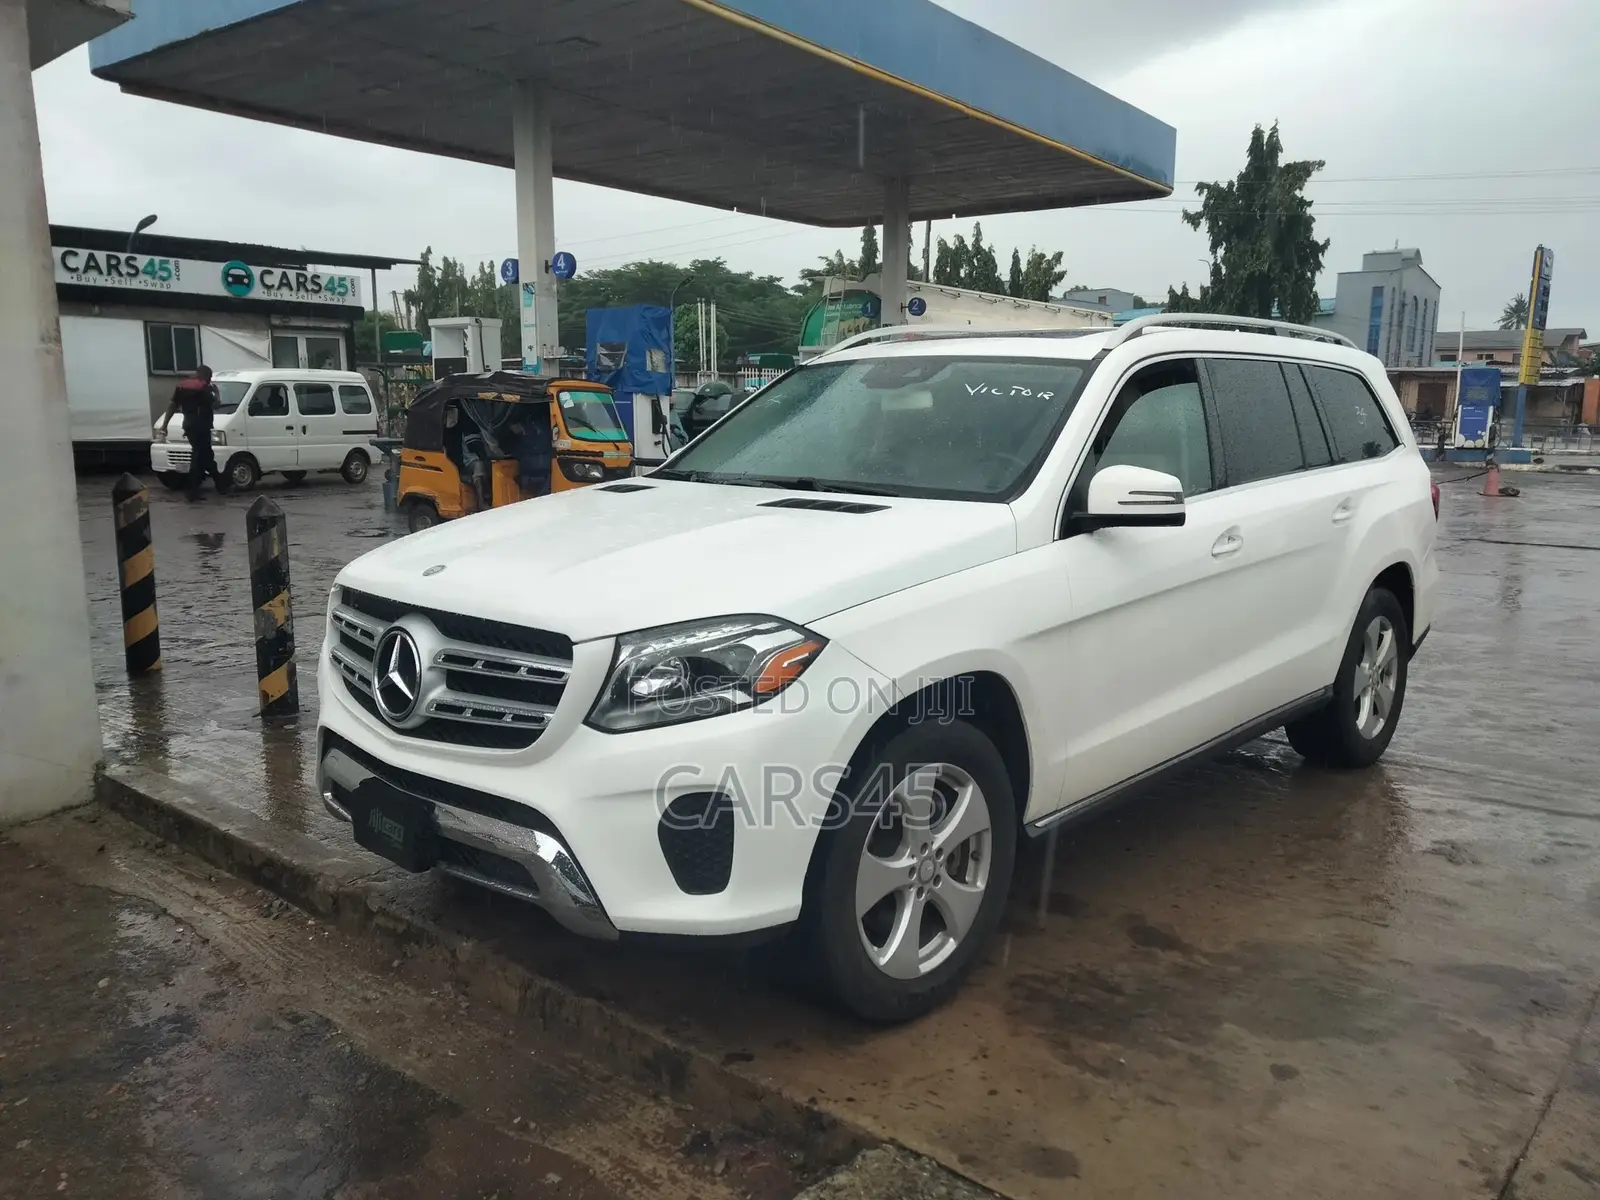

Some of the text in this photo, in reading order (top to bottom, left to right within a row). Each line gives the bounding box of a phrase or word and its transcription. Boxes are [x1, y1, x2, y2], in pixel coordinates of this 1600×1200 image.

[60, 249, 172, 282] CARS45
[506, 261, 513, 276] 3
[557, 253, 566, 270] 4
[259, 269, 349, 297] CARS45
[866, 302, 872, 313] 1
[911, 300, 919, 311] 2
[965, 382, 1055, 400] VICTOR
